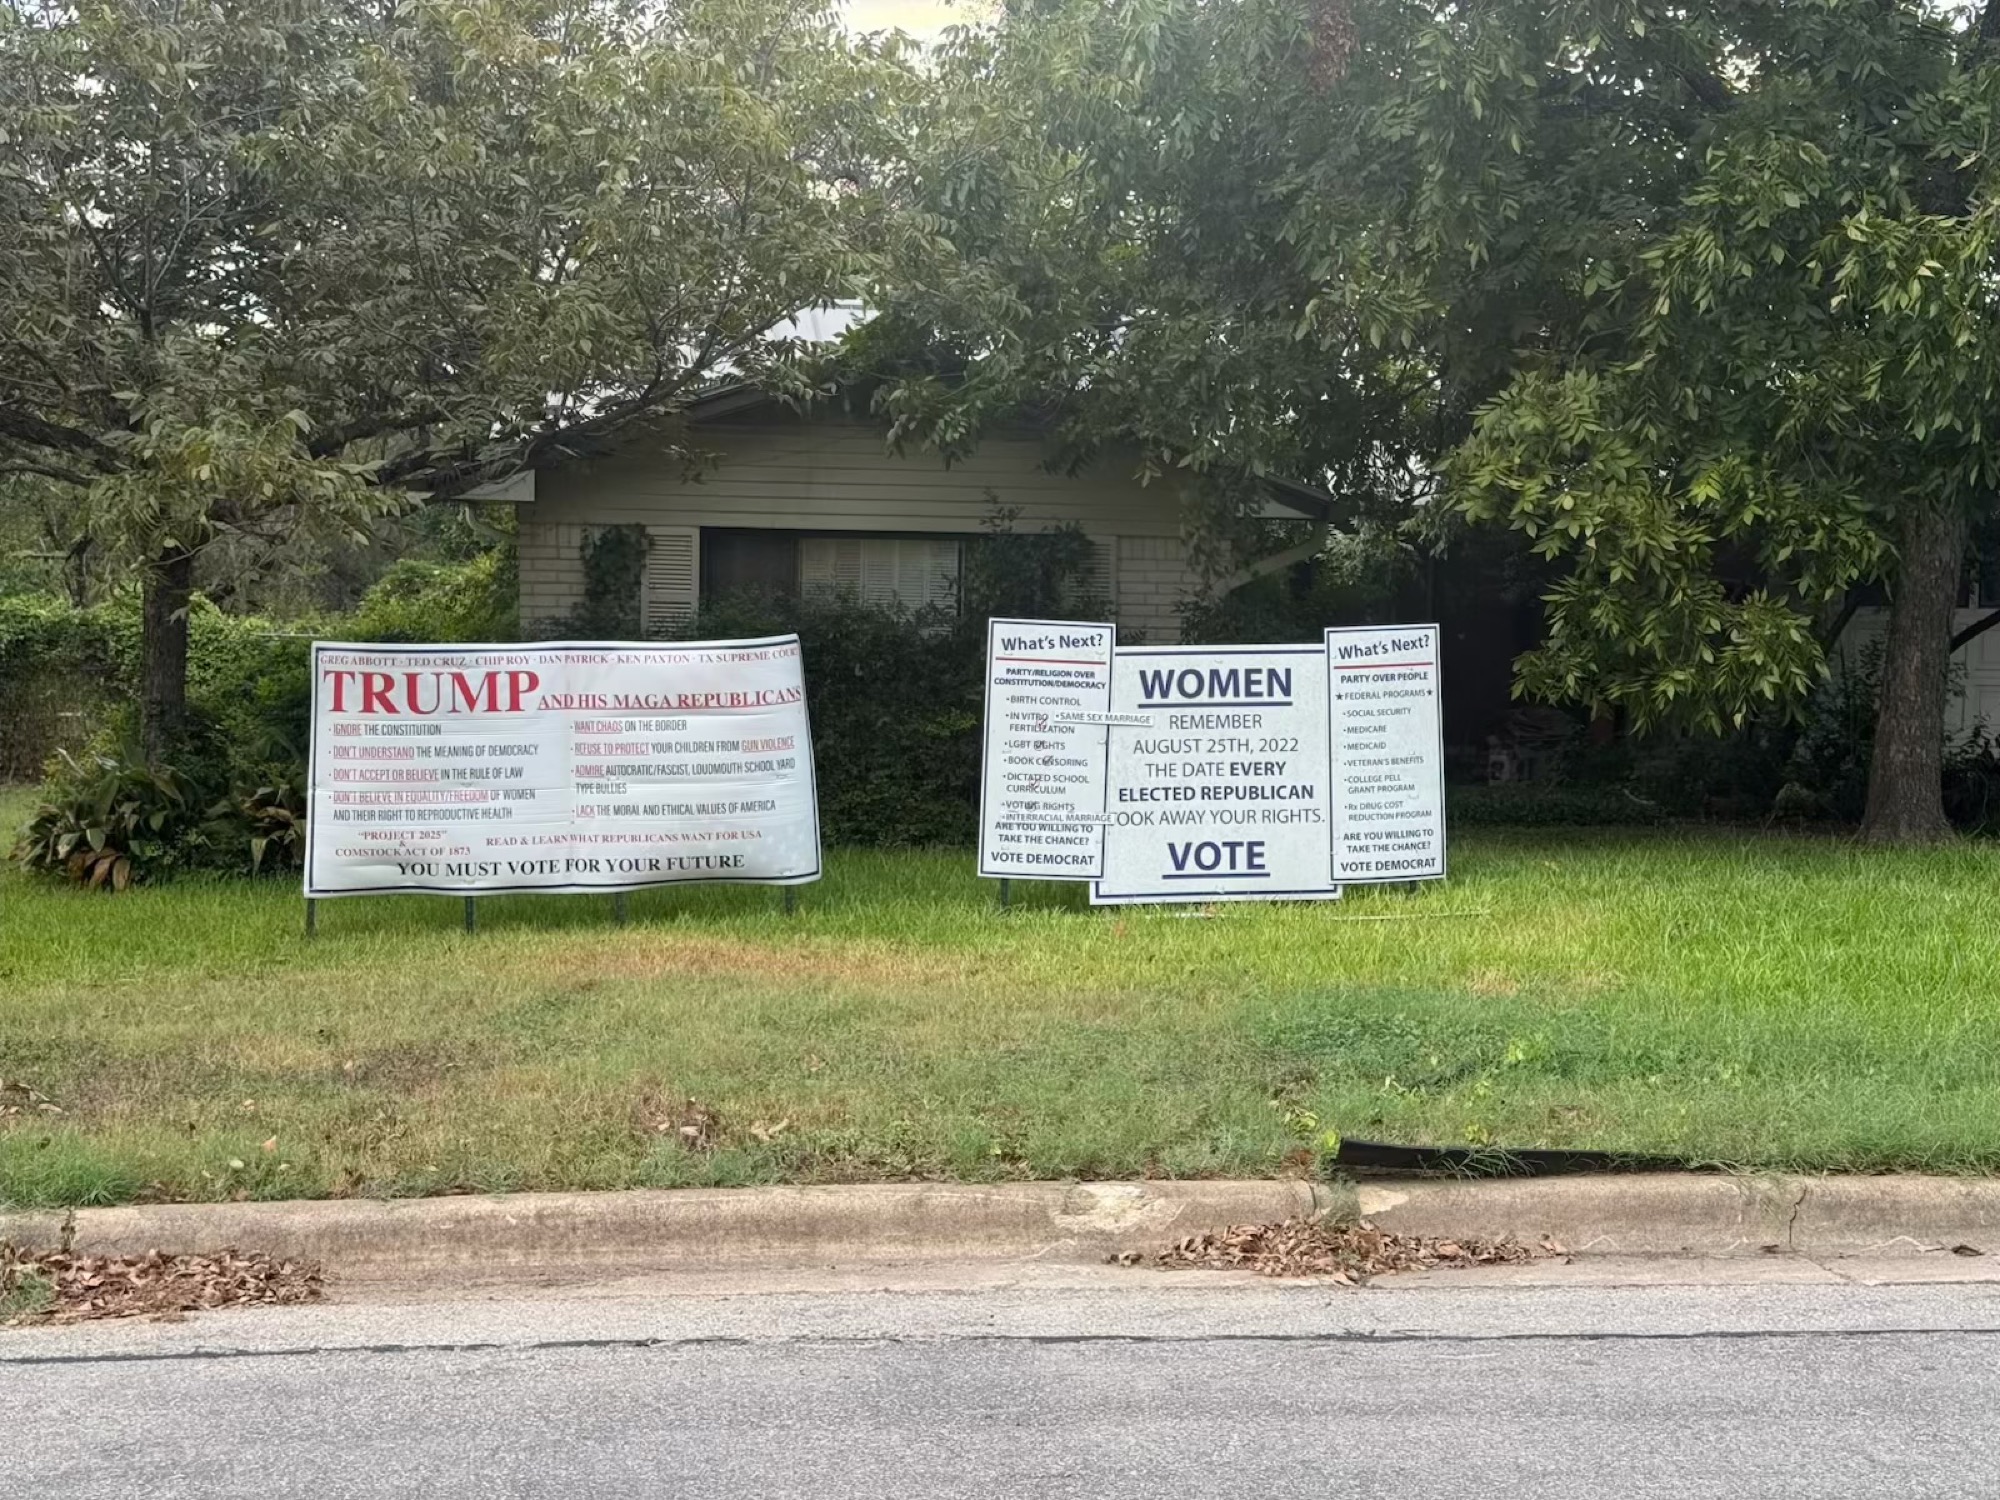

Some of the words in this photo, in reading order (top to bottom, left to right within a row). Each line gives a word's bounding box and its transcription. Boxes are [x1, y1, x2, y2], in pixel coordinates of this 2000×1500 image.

[1001, 636, 1055, 650] What's
[1060, 634, 1103, 648] Next?
[1339, 641, 1388, 659] What's
[1392, 634, 1429, 652] Next?
[321, 655, 348, 665] GREG
[351, 657, 396, 666] ABBOTT
[407, 658, 430, 666] TED
[434, 658, 466, 666] CRUZ
[506, 656, 530, 664] ROY
[539, 655, 561, 664] DAN
[564, 655, 609, 664] PATRICK
[617, 655, 641, 663] KEN
[644, 655, 690, 664] PAXTON
[716, 652, 769, 663] SUPREME
[1006, 668, 1071, 677] PARTY/RELIGION
[1341, 675, 1370, 683] PARTY
[1398, 672, 1428, 680] PEOPLE
[994, 678, 1106, 689] CONSTITUTION/DEMOCRACY
[1139, 668, 1292, 699] WOMEN
[323, 670, 540, 714] TRUMP
[539, 695, 573, 708] AND
[579, 694, 607, 708] HIS
[614, 694, 672, 708] MAGA
[678, 686, 801, 707] REPUBLICANS
[1345, 692, 1381, 700] FEDERAL
[1384, 690, 1425, 698] PROGRAMS
[1011, 696, 1036, 704] BIRTH
[1039, 697, 1081, 706] CONTROL
[1022, 713, 1048, 721] VITRO
[1377, 708, 1411, 716] SECURITY
[1061, 713, 1084, 721] SAME
[1105, 714, 1151, 724] MARRIAGE
[1169, 714, 1262, 729] REMEMBER
[334, 724, 361, 735] IGNORE
[381, 724, 441, 735] CONSTITUTION
[574, 721, 596, 731] WANT
[598, 721, 623, 731] CHAOS
[655, 720, 686, 731] BORDER
[1010, 724, 1074, 733] FERTILIZATION
[1347, 725, 1387, 734] MEDICARE
[575, 743, 602, 754] REFUSE
[616, 742, 649, 754] PROTECT
[651, 742, 672, 753] YOUR
[675, 742, 714, 753] CHILDREN
[716, 741, 740, 751] FROM
[741, 740, 758, 751] GUN
[760, 736, 794, 750] VIOLENCE
[1009, 740, 1030, 748] LGBT
[1133, 739, 1201, 754] AUGUST
[1207, 739, 1254, 754] 25TH,
[1259, 739, 1298, 752] 2022
[1347, 742, 1386, 750] MEDICAID
[334, 746, 356, 758] DON'T
[359, 747, 414, 758] UNDERSTAND
[435, 746, 473, 757] MEANING
[489, 744, 538, 756] DEMOCRACY
[1009, 757, 1034, 765] BOOK
[1391, 756, 1424, 765] BENEFITS
[575, 765, 604, 776] ADMIRE
[692, 762, 742, 775] LOUDMOUTH
[745, 759, 774, 773] SCHOOL
[777, 758, 795, 769] YARD
[1145, 764, 1176, 777] THE
[1183, 763, 1224, 776] DATE
[1230, 762, 1286, 775] EVERY
[334, 769, 356, 780] DON'T
[359, 769, 389, 780] ACCEPT
[406, 769, 439, 780] BELIEVE
[470, 768, 490, 779] RULE
[505, 767, 523, 778] LAW
[1007, 773, 1050, 782] DICTATED
[1053, 775, 1090, 784] SCHOOL
[576, 783, 594, 794] TYPE
[596, 783, 627, 794] BULLIES
[1006, 785, 1066, 794] CURRICULUM
[1119, 788, 1195, 802] ELECTED
[1201, 785, 1314, 799] REPUBLICAN
[1377, 784, 1415, 793] PROGRAM
[334, 791, 356, 803] DON'T
[359, 791, 391, 803] BELIEVE
[406, 791, 489, 802] EQUALITY/FREEDOM
[503, 789, 535, 800] WOMEN
[576, 805, 595, 816] LACK
[614, 804, 640, 816] MORAL
[662, 803, 694, 815] ETHICAL
[697, 802, 726, 815] VALUES
[740, 800, 775, 812] AMERICA
[1360, 802, 1381, 810] DRUG
[1384, 801, 1403, 809] COST
[353, 810, 376, 821] THEIR
[378, 809, 402, 820] RIGHT
[418, 809, 479, 820] REPRODUCTIVE
[481, 808, 512, 819] HEALTH
[1159, 810, 1206, 825] AWAY
[1210, 810, 1256, 824] YOUR
[1262, 809, 1325, 823] RIGHTS.
[1349, 813, 1394, 821] REDUCTION
[1396, 810, 1432, 819] PROGRAM
[1039, 824, 1079, 832] WILLING
[1082, 824, 1093, 832] TO
[486, 837, 517, 846] READ
[532, 836, 568, 845] LEARN
[570, 834, 599, 843] WHAT
[602, 833, 678, 843] REPUBLICANS
[682, 833, 712, 841] WANT
[716, 832, 737, 840] FOR
[741, 830, 762, 839] USA
[999, 835, 1022, 843] TAKE
[1025, 835, 1043, 844] THE
[1045, 836, 1089, 845] CHANCE?
[1364, 832, 1382, 840] YOU
[1385, 830, 1421, 839] WILLING
[335, 848, 402, 857] COMSTOCK
[405, 848, 425, 856] ACT
[450, 847, 470, 855] 1873
[1348, 845, 1370, 853] TAKE
[1392, 841, 1430, 851] CHANCE?
[991, 852, 1023, 863] VOTE
[1026, 855, 1094, 865] DEMOCRAT
[1168, 841, 1265, 871] VOTE
[398, 862, 439, 876] YOU
[446, 862, 501, 876] MUST
[508, 859, 560, 874] VOTE
[565, 859, 600, 873] FOR
[606, 857, 660, 872] YOUR
[667, 855, 745, 870] FUTURE
[1341, 862, 1372, 871] VOTE
[1376, 858, 1436, 870] DEMOCRAT
